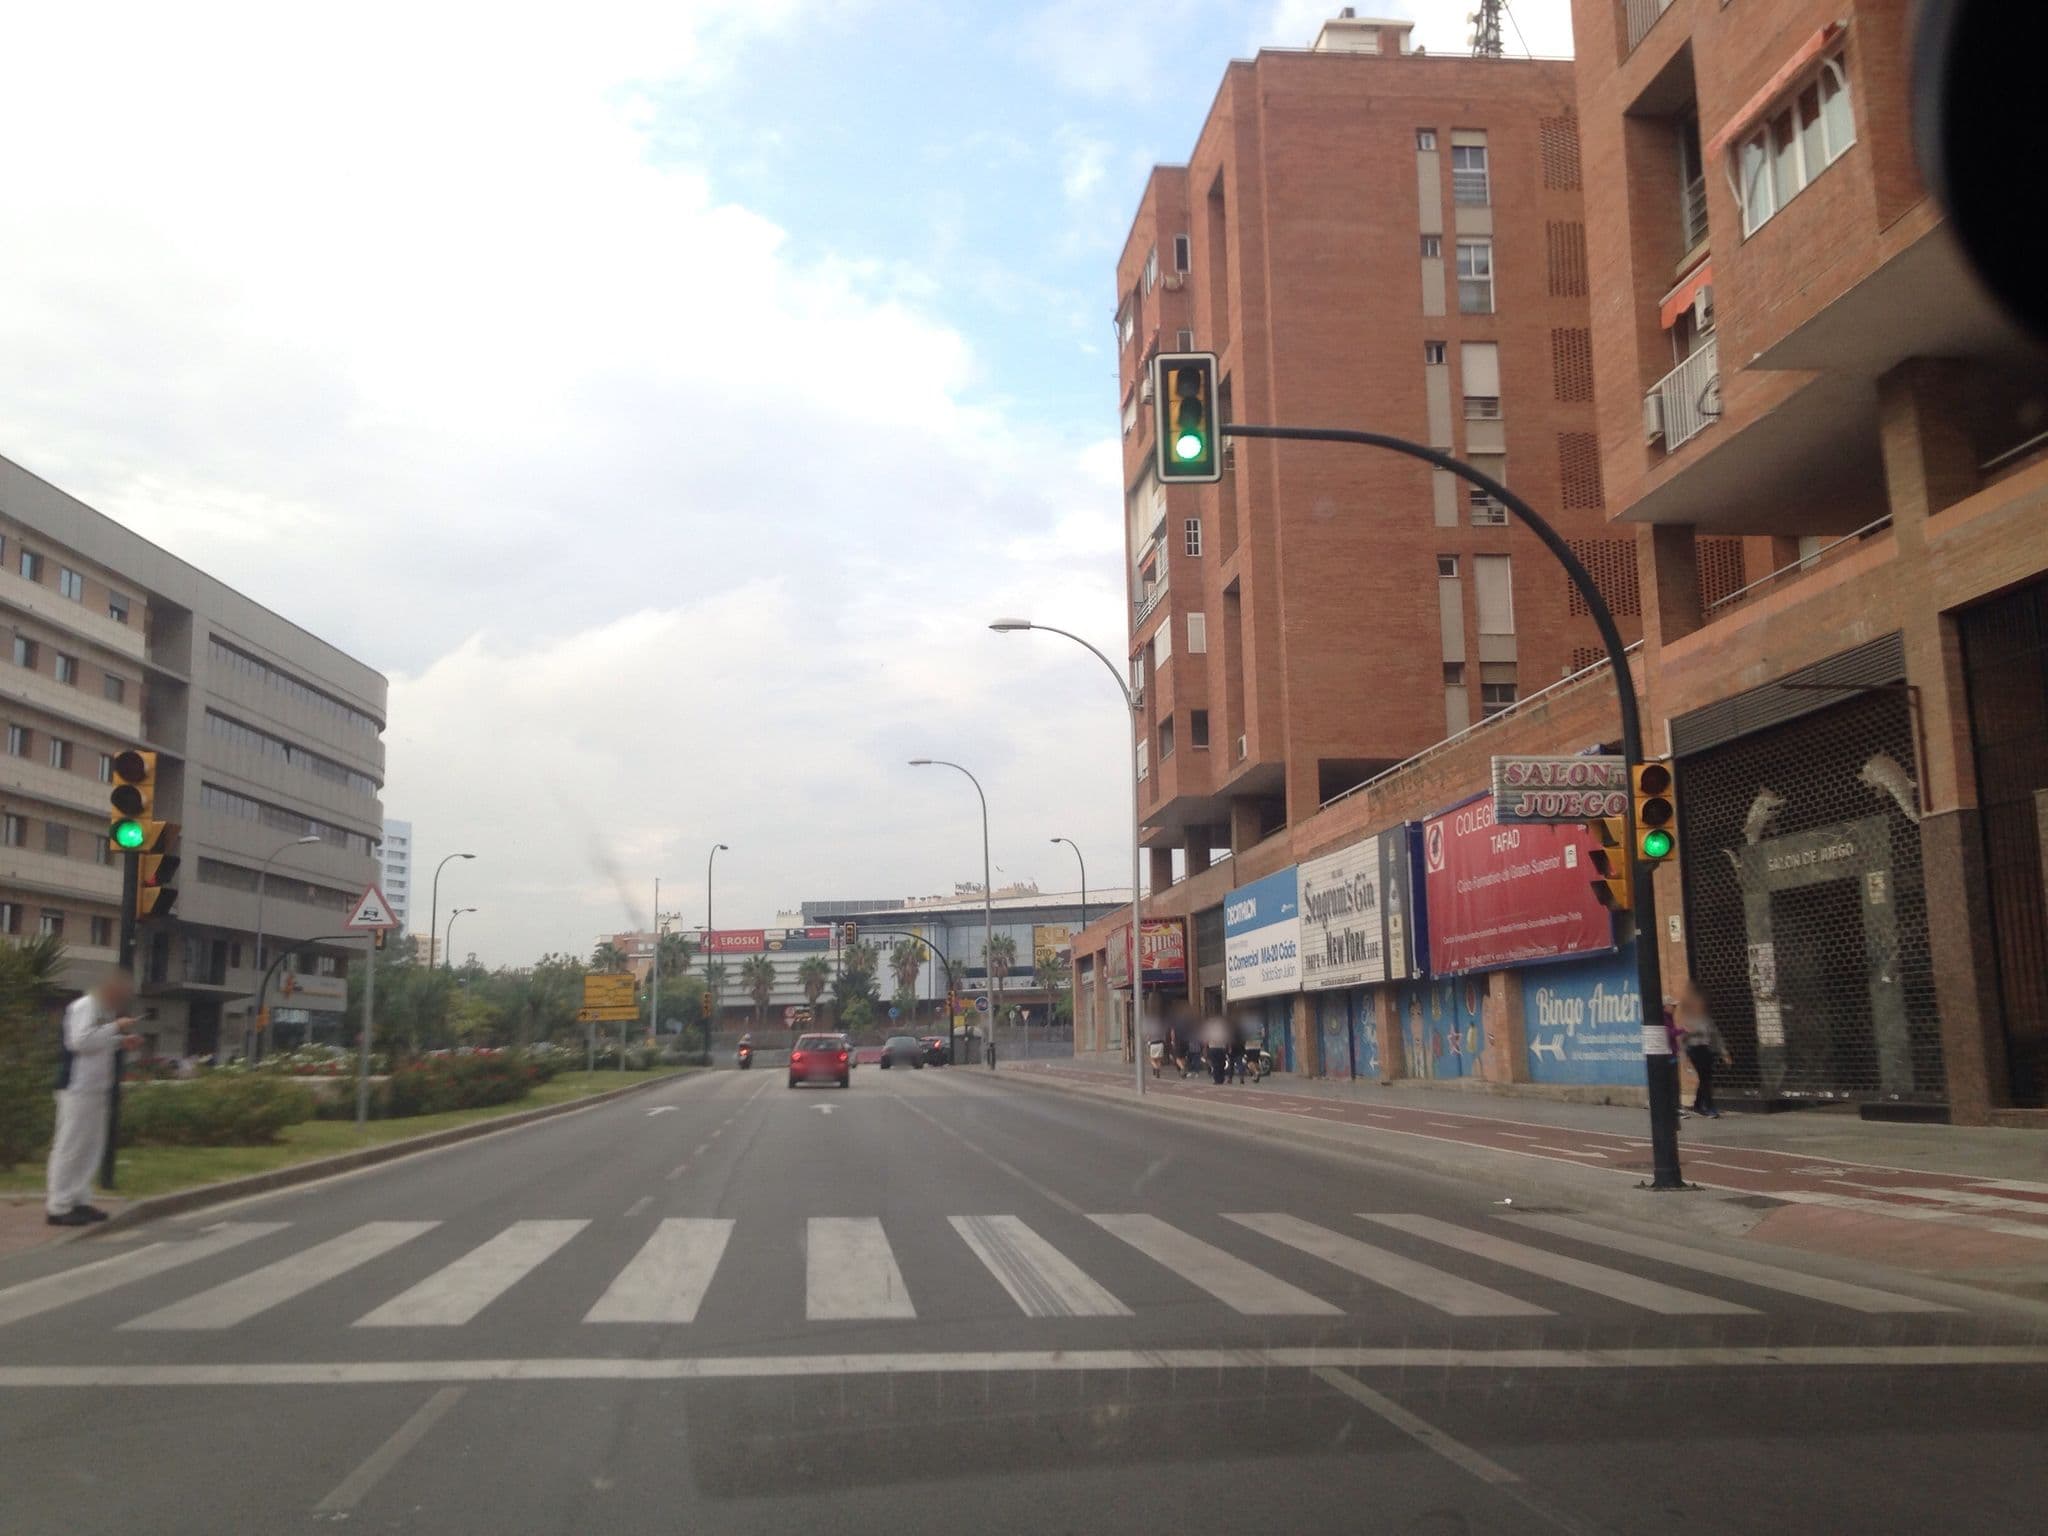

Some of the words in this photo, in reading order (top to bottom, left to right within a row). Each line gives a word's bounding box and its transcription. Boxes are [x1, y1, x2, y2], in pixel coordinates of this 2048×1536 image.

[1504, 762, 1612, 787] SALON
[1456, 803, 1494, 836] COLEGI
[1491, 829, 1520, 855] TAFAD
[1354, 873, 1376, 912] Gin
[720, 936, 760, 946] EROSKI
[1536, 987, 1584, 1036] Bingo
